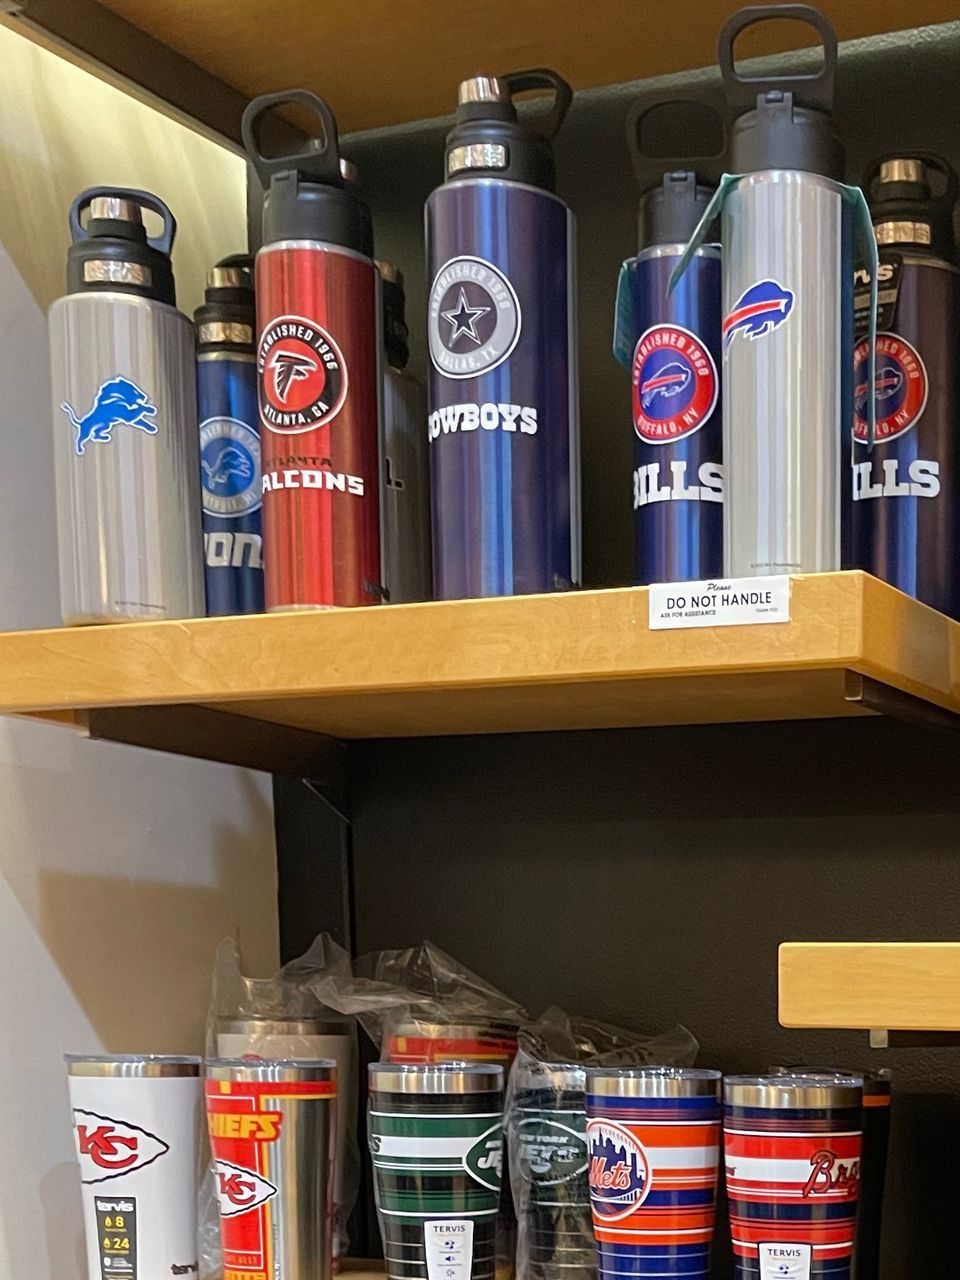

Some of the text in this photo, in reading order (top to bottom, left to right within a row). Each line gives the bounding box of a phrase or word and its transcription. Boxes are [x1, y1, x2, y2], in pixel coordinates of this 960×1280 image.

[315, 338, 339, 370] 1966
[262, 469, 364, 496] ALCONS
[633, 460, 724, 511] ILLS
[667, 591, 772, 610] DO NOT HANDLE
[207, 1113, 282, 1139] HIEFS
[115, 1216, 125, 1228] 8
[433, 1225, 466, 1233] TERVIS
[113, 1237, 130, 1250] 24
[768, 1248, 801, 1257] TERVIS
